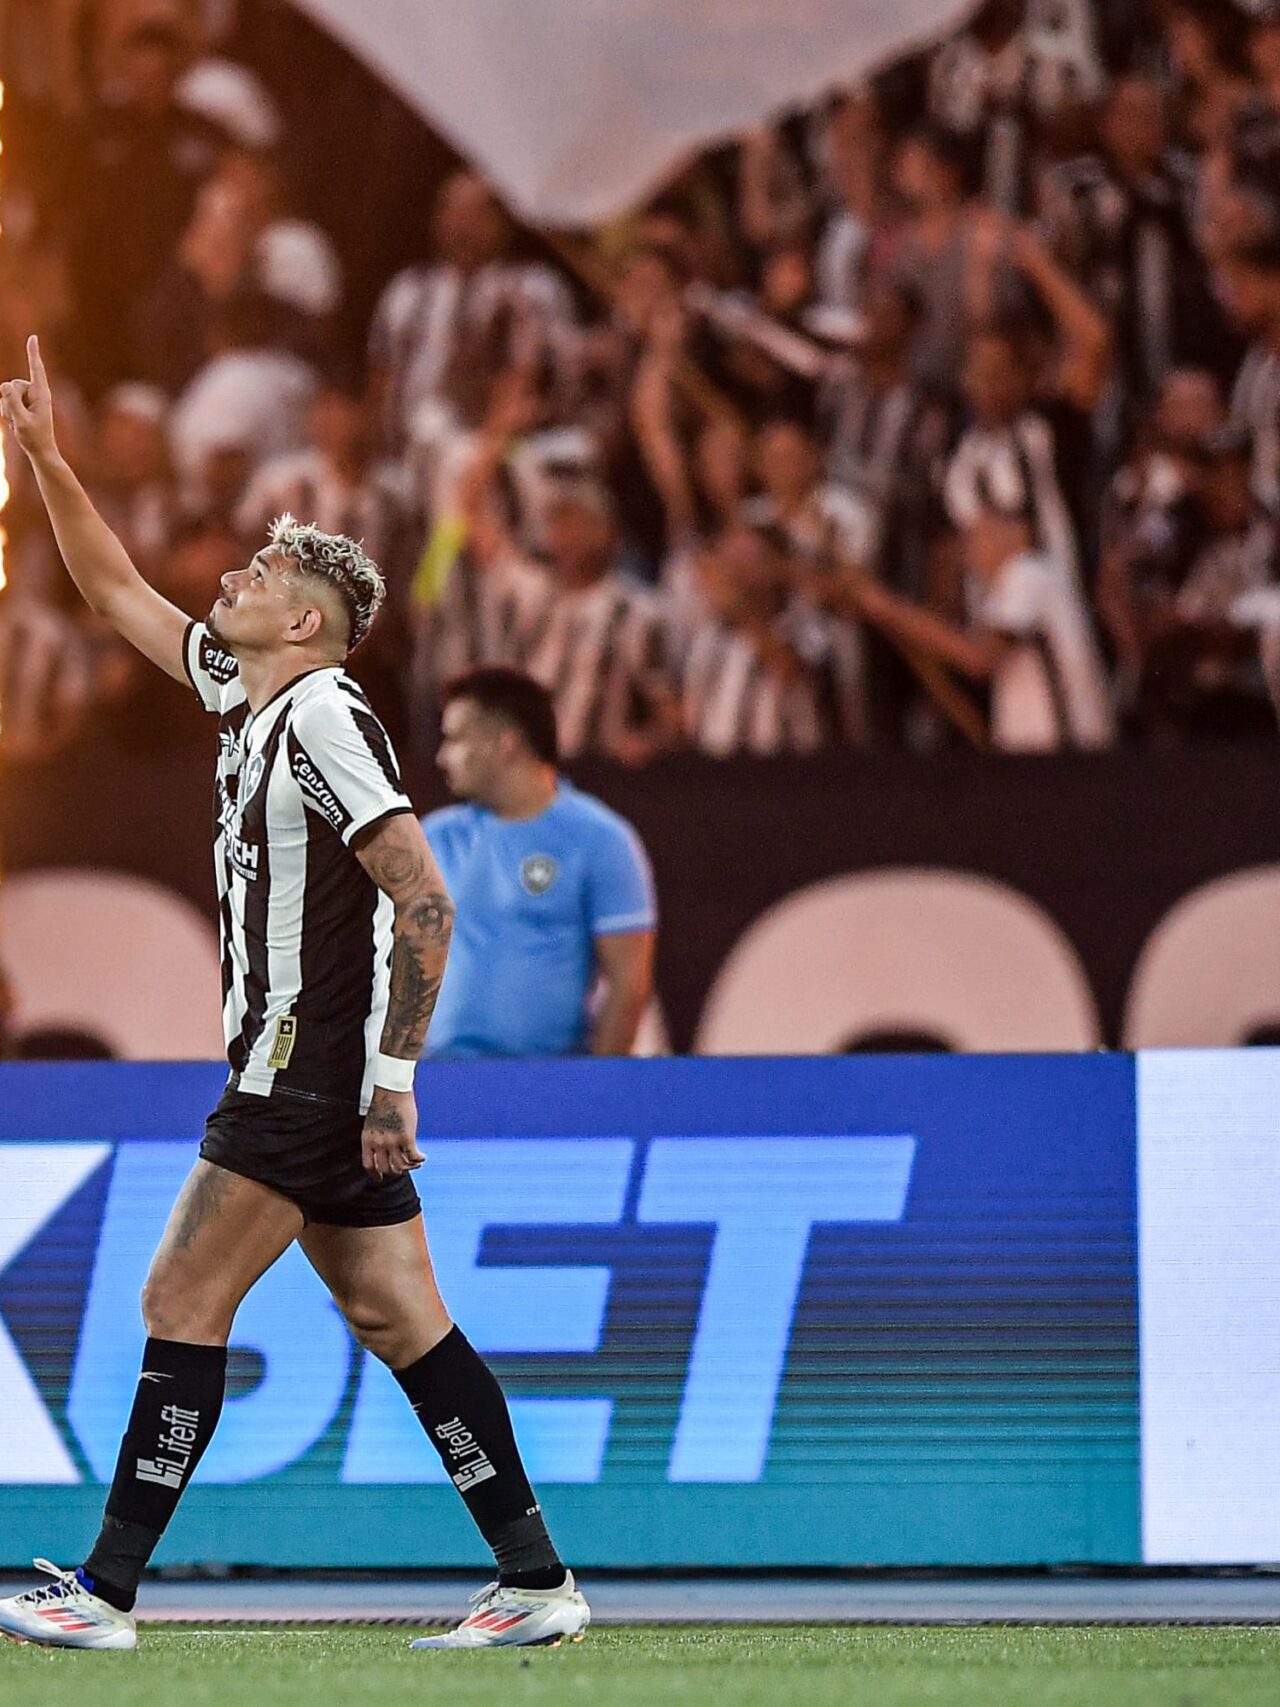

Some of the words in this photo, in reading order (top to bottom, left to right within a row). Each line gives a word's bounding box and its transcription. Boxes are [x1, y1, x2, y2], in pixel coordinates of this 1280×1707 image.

[293, 752, 344, 823] centrum
[155, 1404, 200, 1470] Lifefit
[434, 1416, 488, 1472] Lifefit
